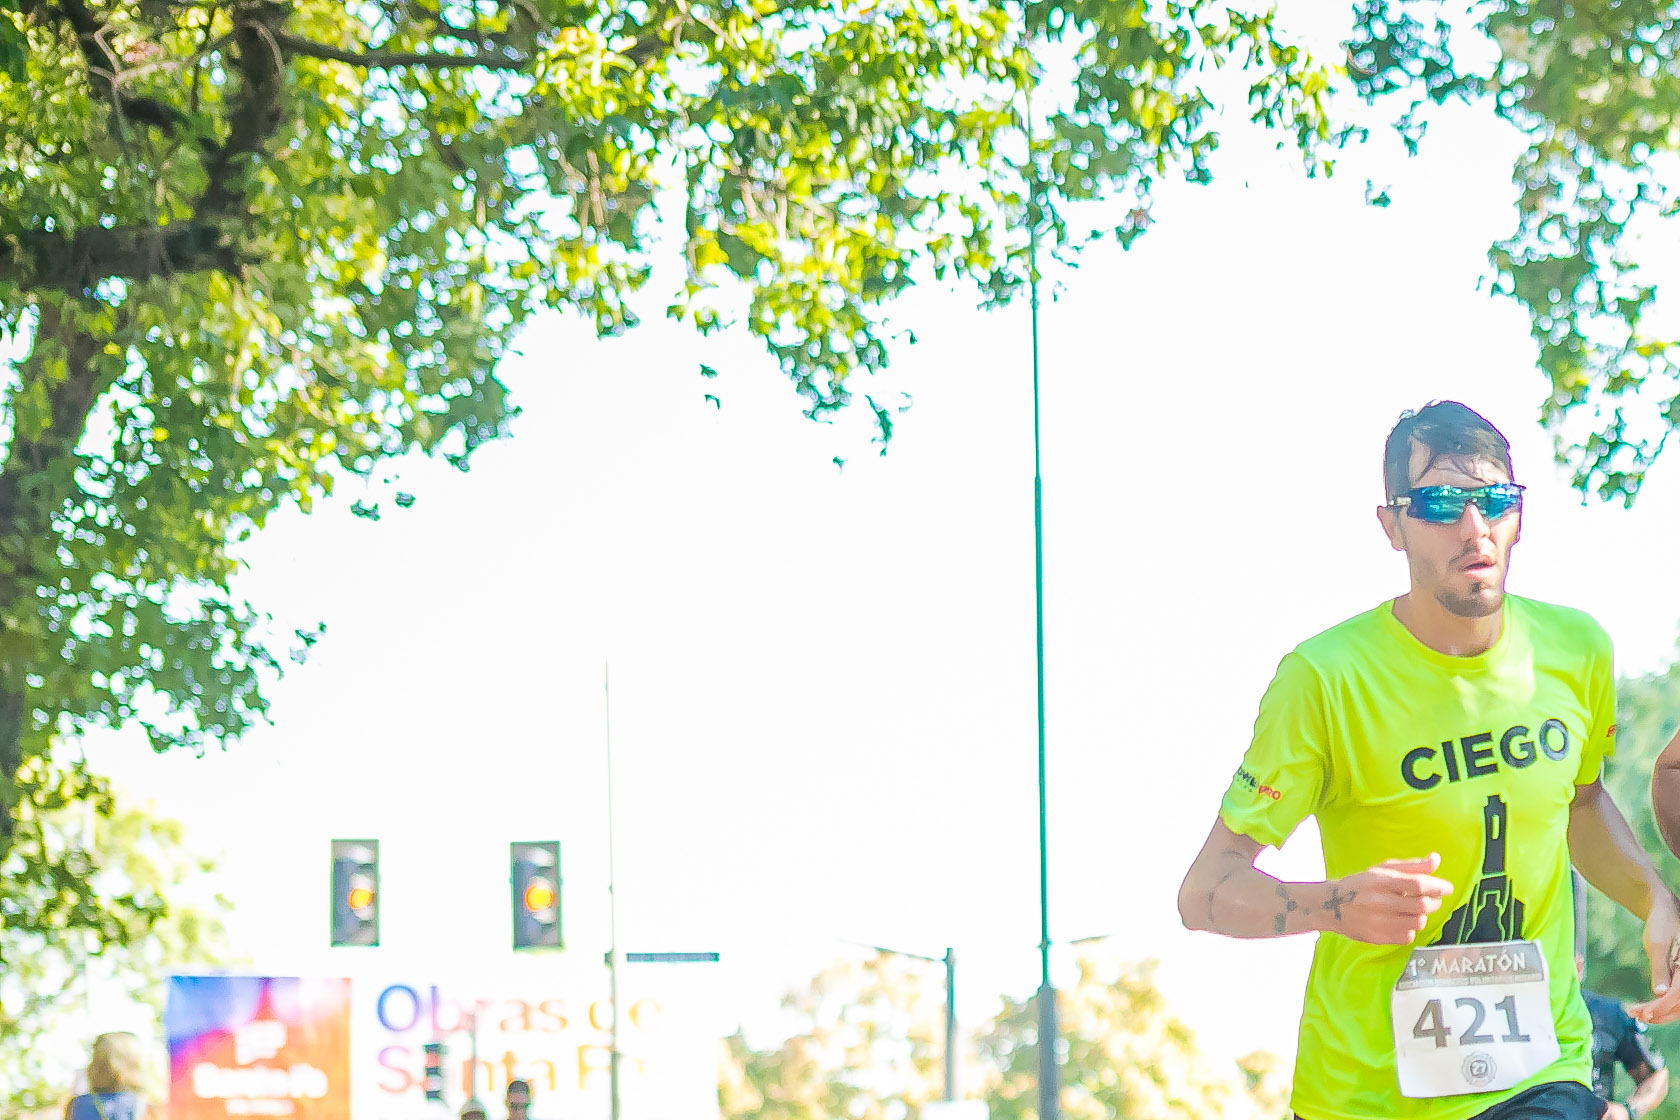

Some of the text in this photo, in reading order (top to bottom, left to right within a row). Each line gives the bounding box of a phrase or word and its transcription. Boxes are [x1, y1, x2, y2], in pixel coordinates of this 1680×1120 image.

[1401, 718, 1569, 791] CIEGO
[1432, 949, 1526, 975] MARATÓN
[376, 984, 568, 1033] Obras
[1412, 995, 1531, 1048] 421
[377, 1045, 556, 1094] Snta
